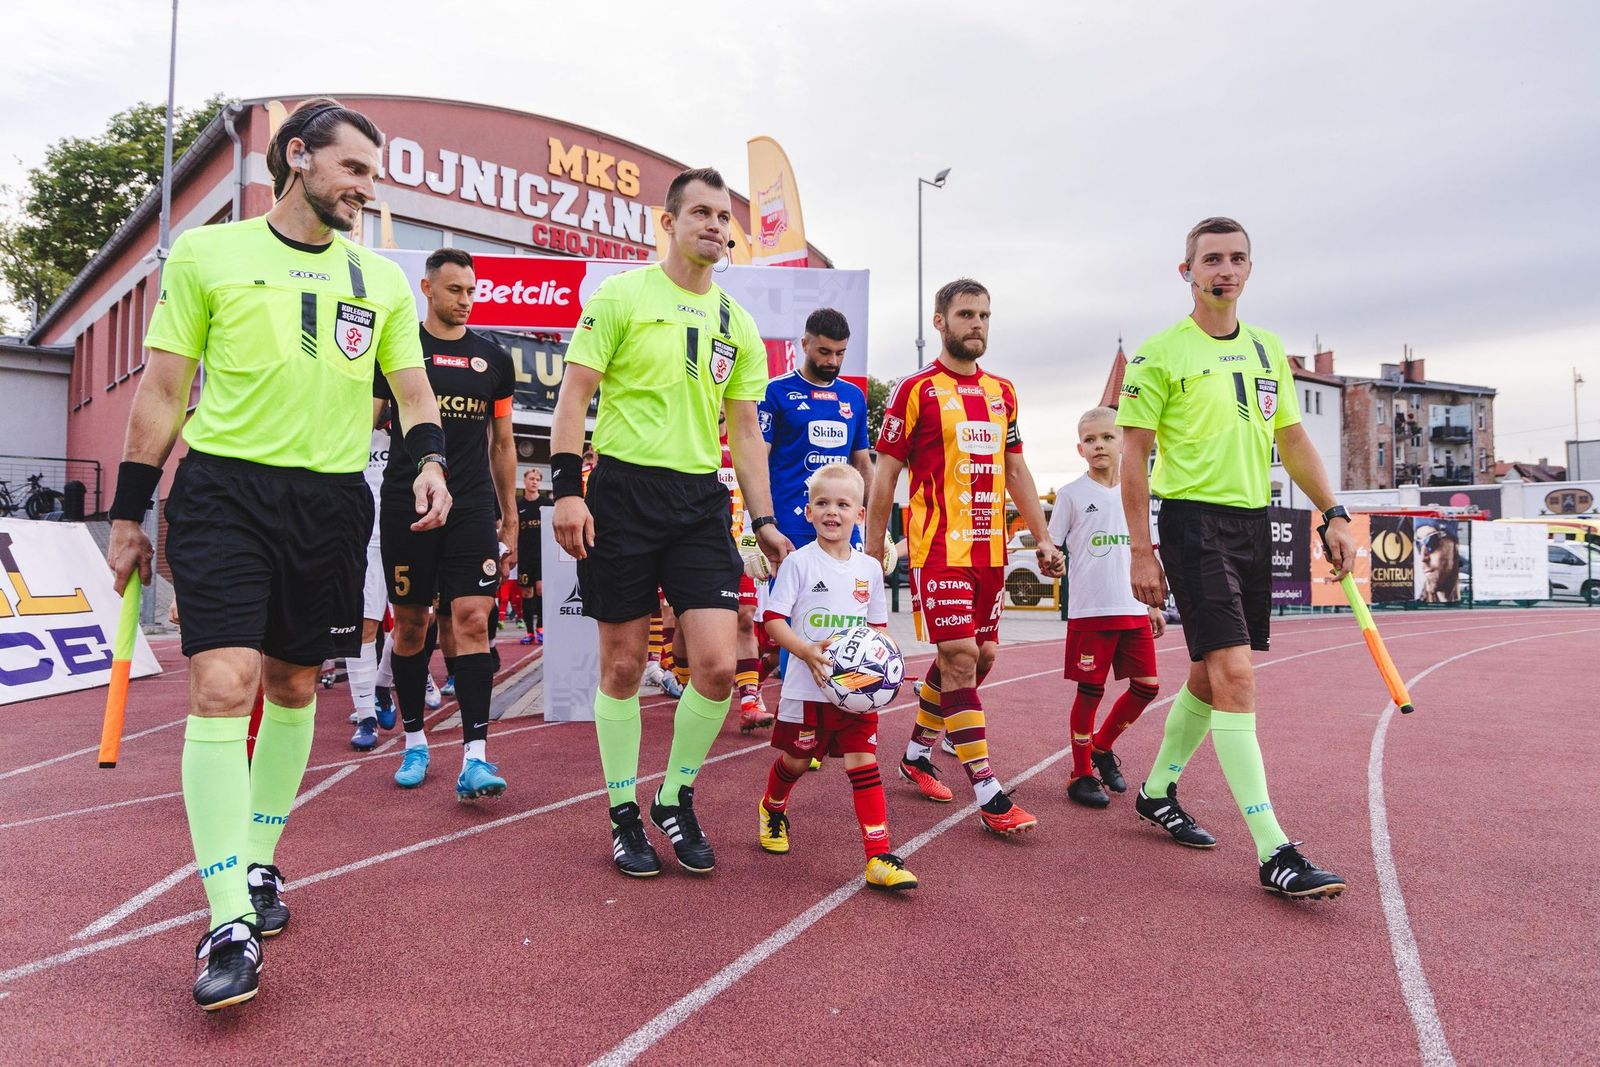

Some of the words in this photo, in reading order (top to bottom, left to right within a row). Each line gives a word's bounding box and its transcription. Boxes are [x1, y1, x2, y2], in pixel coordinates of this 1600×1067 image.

[548, 137, 641, 198] MKS
[377, 133, 657, 246] OJNICZAN
[473, 279, 572, 307] Betclic
[436, 356, 466, 368] Betclic
[957, 386, 983, 395] Betclic
[1121, 385, 1141, 396] LACK
[812, 425, 844, 438] Skiba
[962, 427, 998, 443] Skiba
[0, 532, 94, 619] L
[394, 565, 411, 597] 5
[1372, 567, 1414, 581] CENTRUM
[330, 625, 356, 634] zina
[842, 627, 871, 664] SELECT
